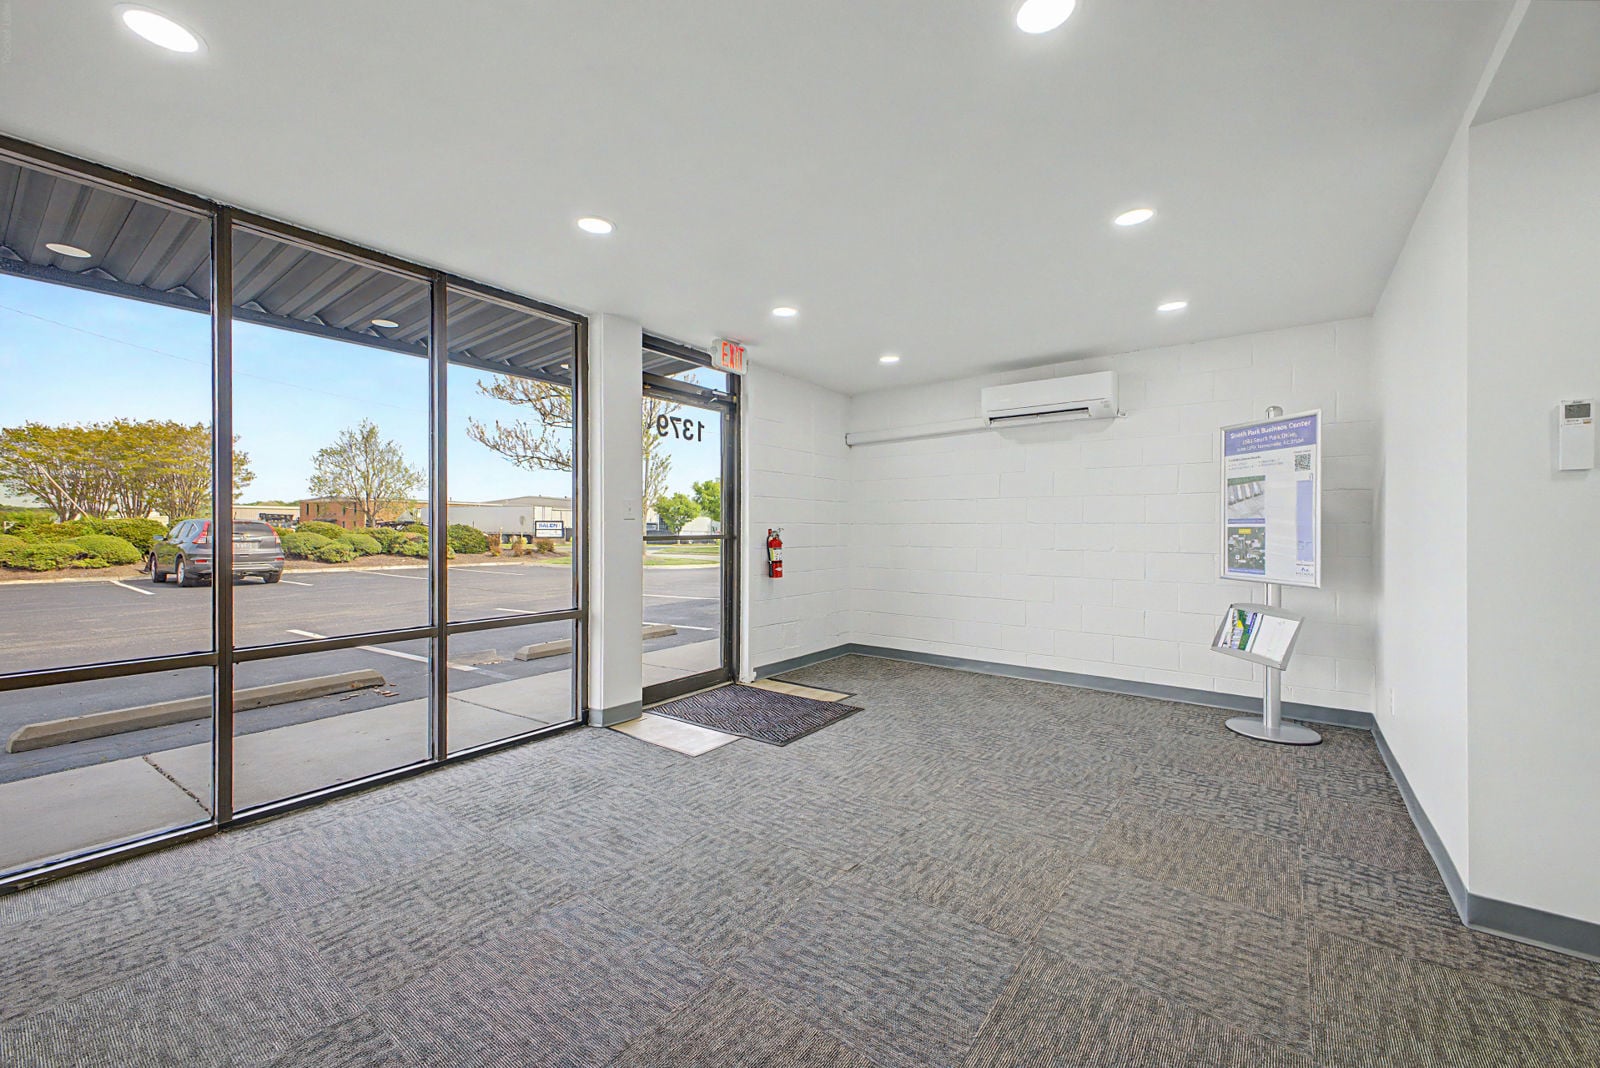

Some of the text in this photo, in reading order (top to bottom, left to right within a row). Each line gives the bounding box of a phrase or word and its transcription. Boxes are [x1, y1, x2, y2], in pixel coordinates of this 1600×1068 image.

[722, 341, 744, 371] EXIT
[1261, 425, 1288, 433] Business
[1288, 420, 1311, 428] Center
